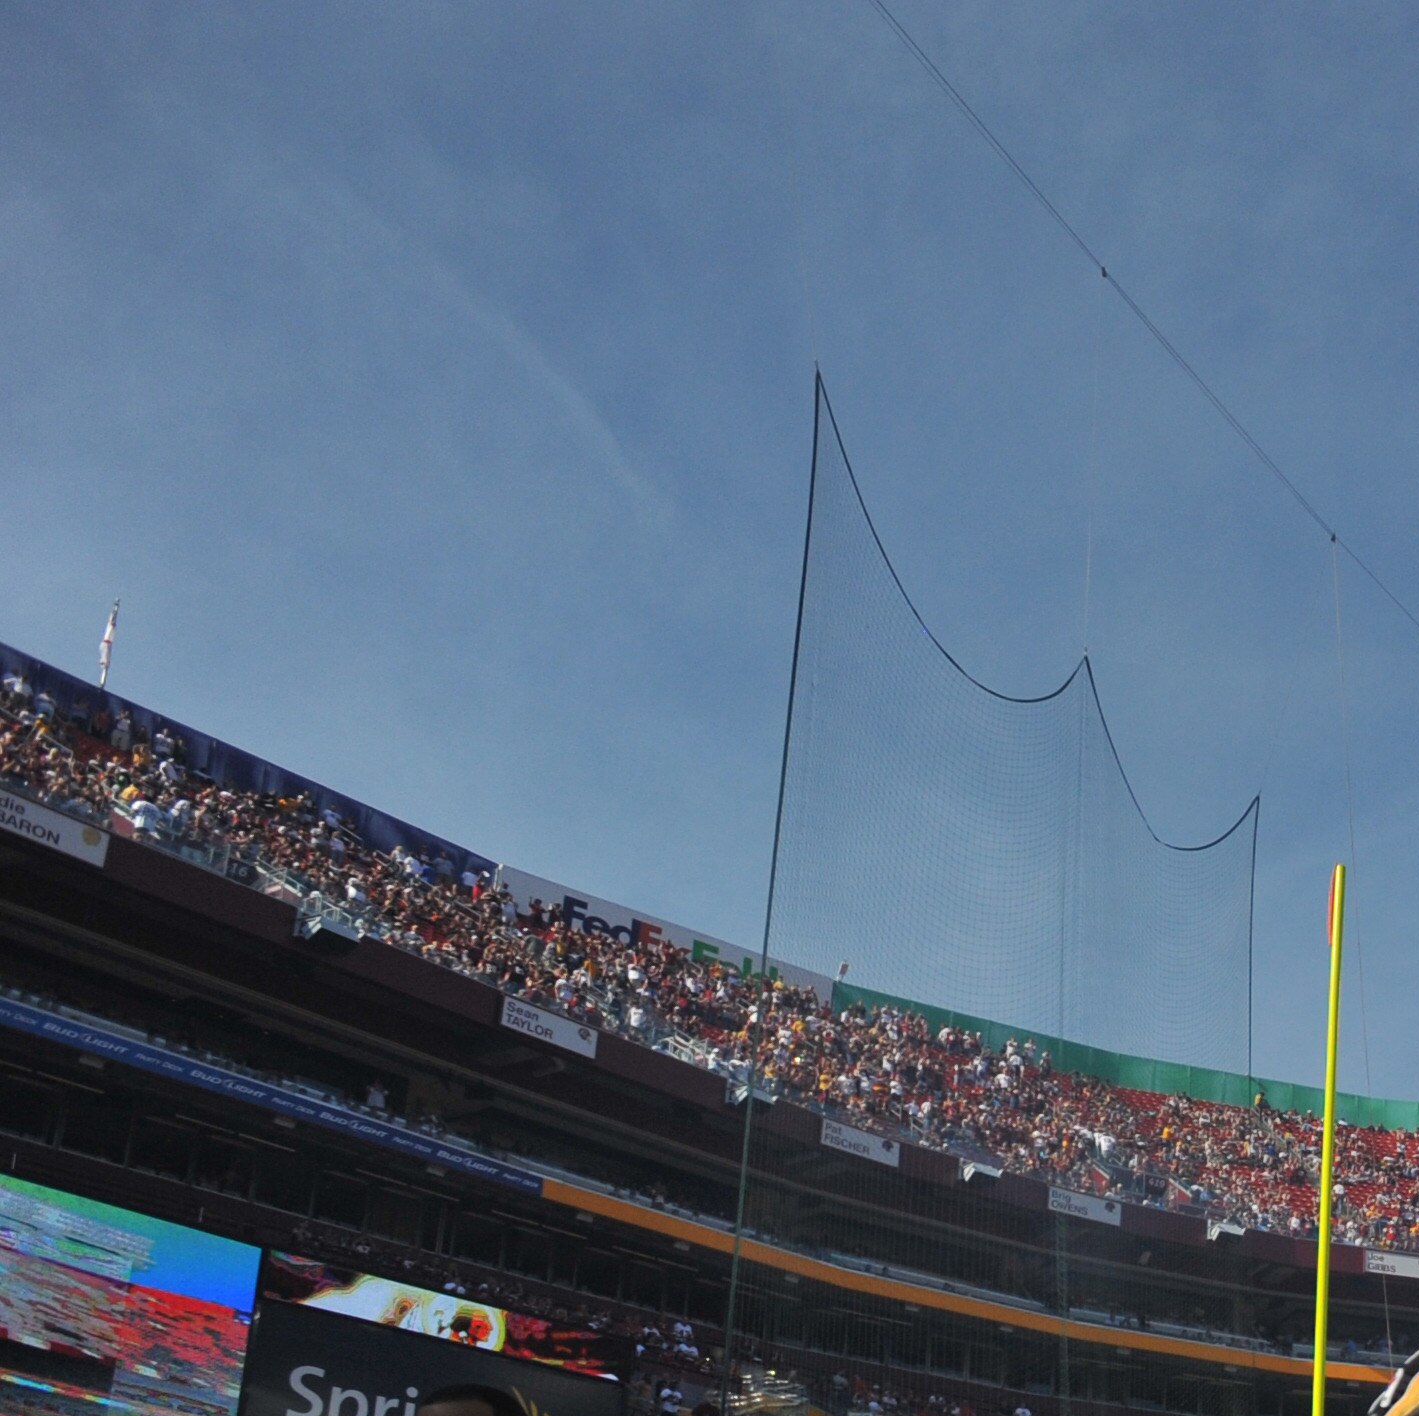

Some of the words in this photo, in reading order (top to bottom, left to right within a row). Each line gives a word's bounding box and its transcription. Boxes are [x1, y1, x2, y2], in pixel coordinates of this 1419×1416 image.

[506, 1001, 539, 1021] Sean
[506, 1013, 554, 1039] TAYLOR
[825, 1122, 843, 1135] Pat
[823, 1133, 871, 1156] FISCHER
[1051, 1199, 1089, 1217] OWENS
[1368, 1252, 1385, 1262] Joe
[1368, 1262, 1397, 1274] GIBBS
